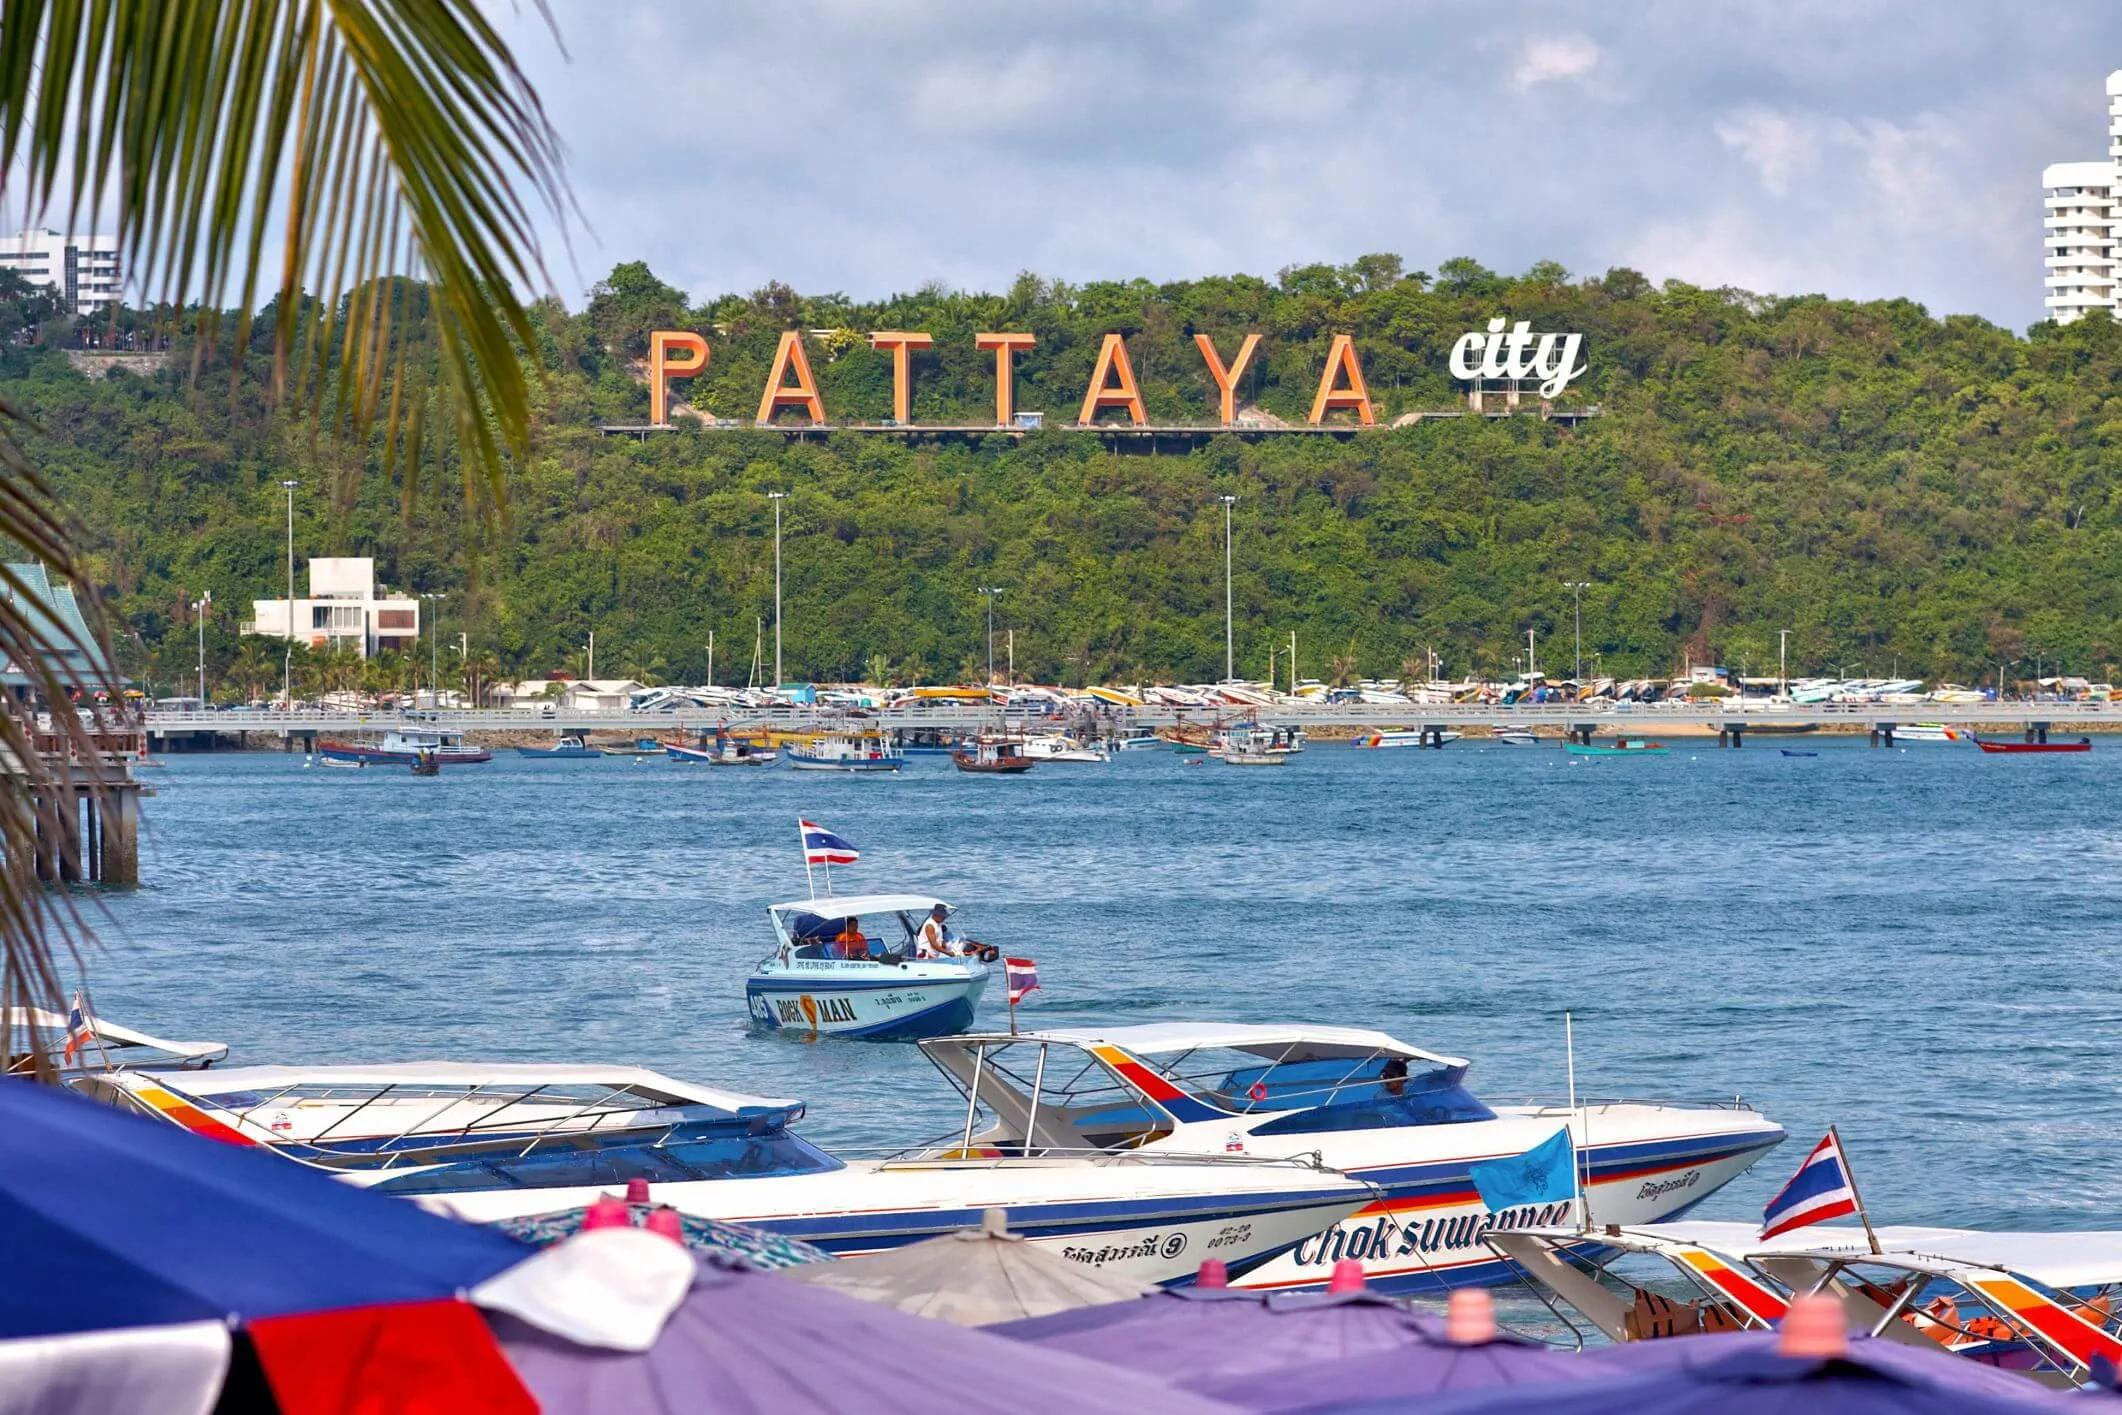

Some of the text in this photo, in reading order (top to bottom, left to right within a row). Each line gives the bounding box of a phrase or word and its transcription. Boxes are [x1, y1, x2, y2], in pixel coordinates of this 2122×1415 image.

[650, 316, 1588, 427] PATTAYA city
[775, 999, 804, 1023] ROCK
[816, 998, 858, 1023] MAN
[1292, 1215, 1397, 1266] Chok
